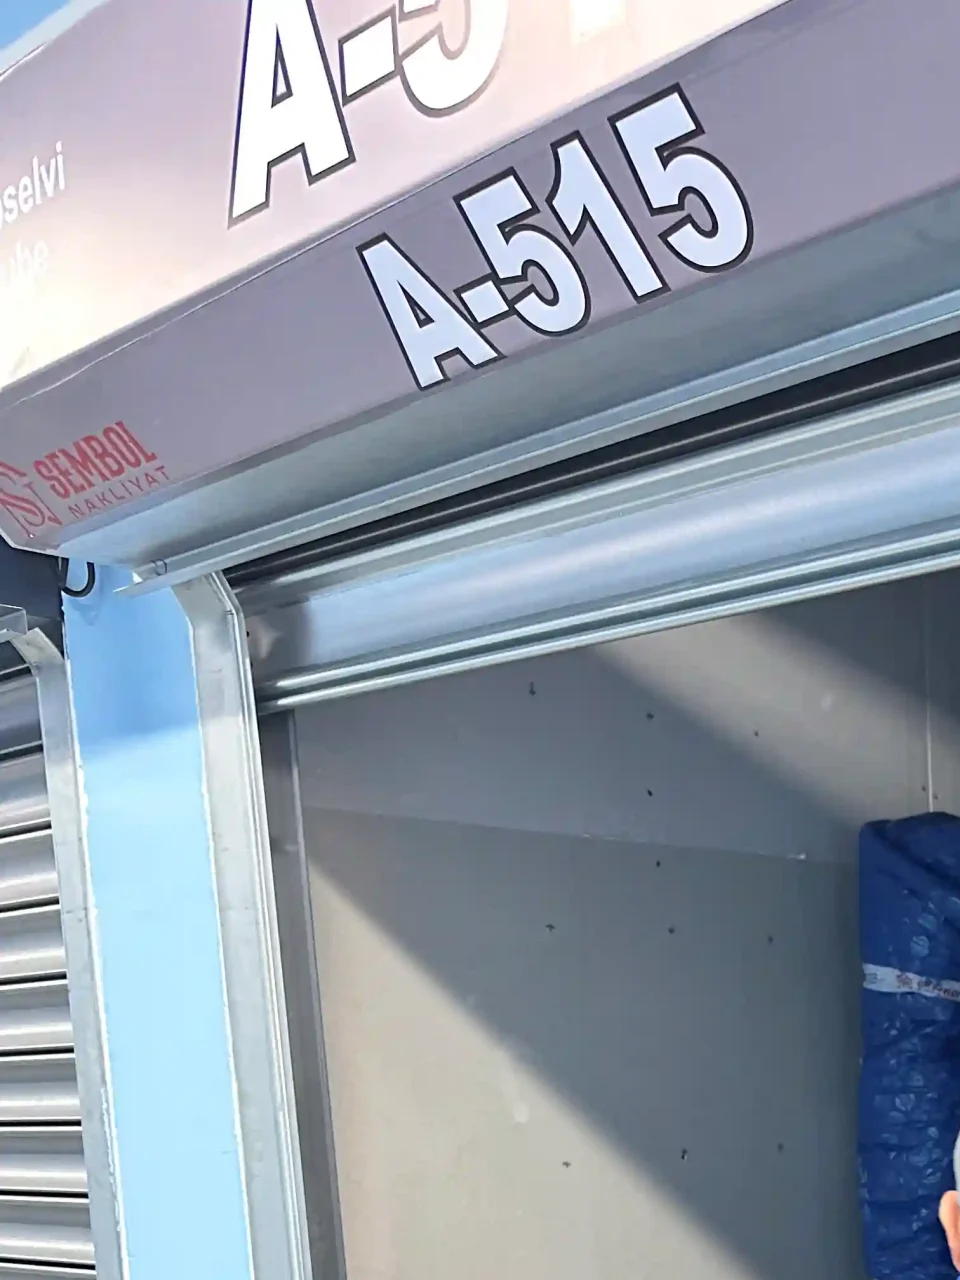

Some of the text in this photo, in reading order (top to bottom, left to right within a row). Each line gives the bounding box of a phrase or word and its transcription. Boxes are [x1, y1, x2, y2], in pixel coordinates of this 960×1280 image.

[0, 140, 65, 230] selvi
[355, 82, 754, 390] A-515
[33, 419, 157, 499] SEMBOL
